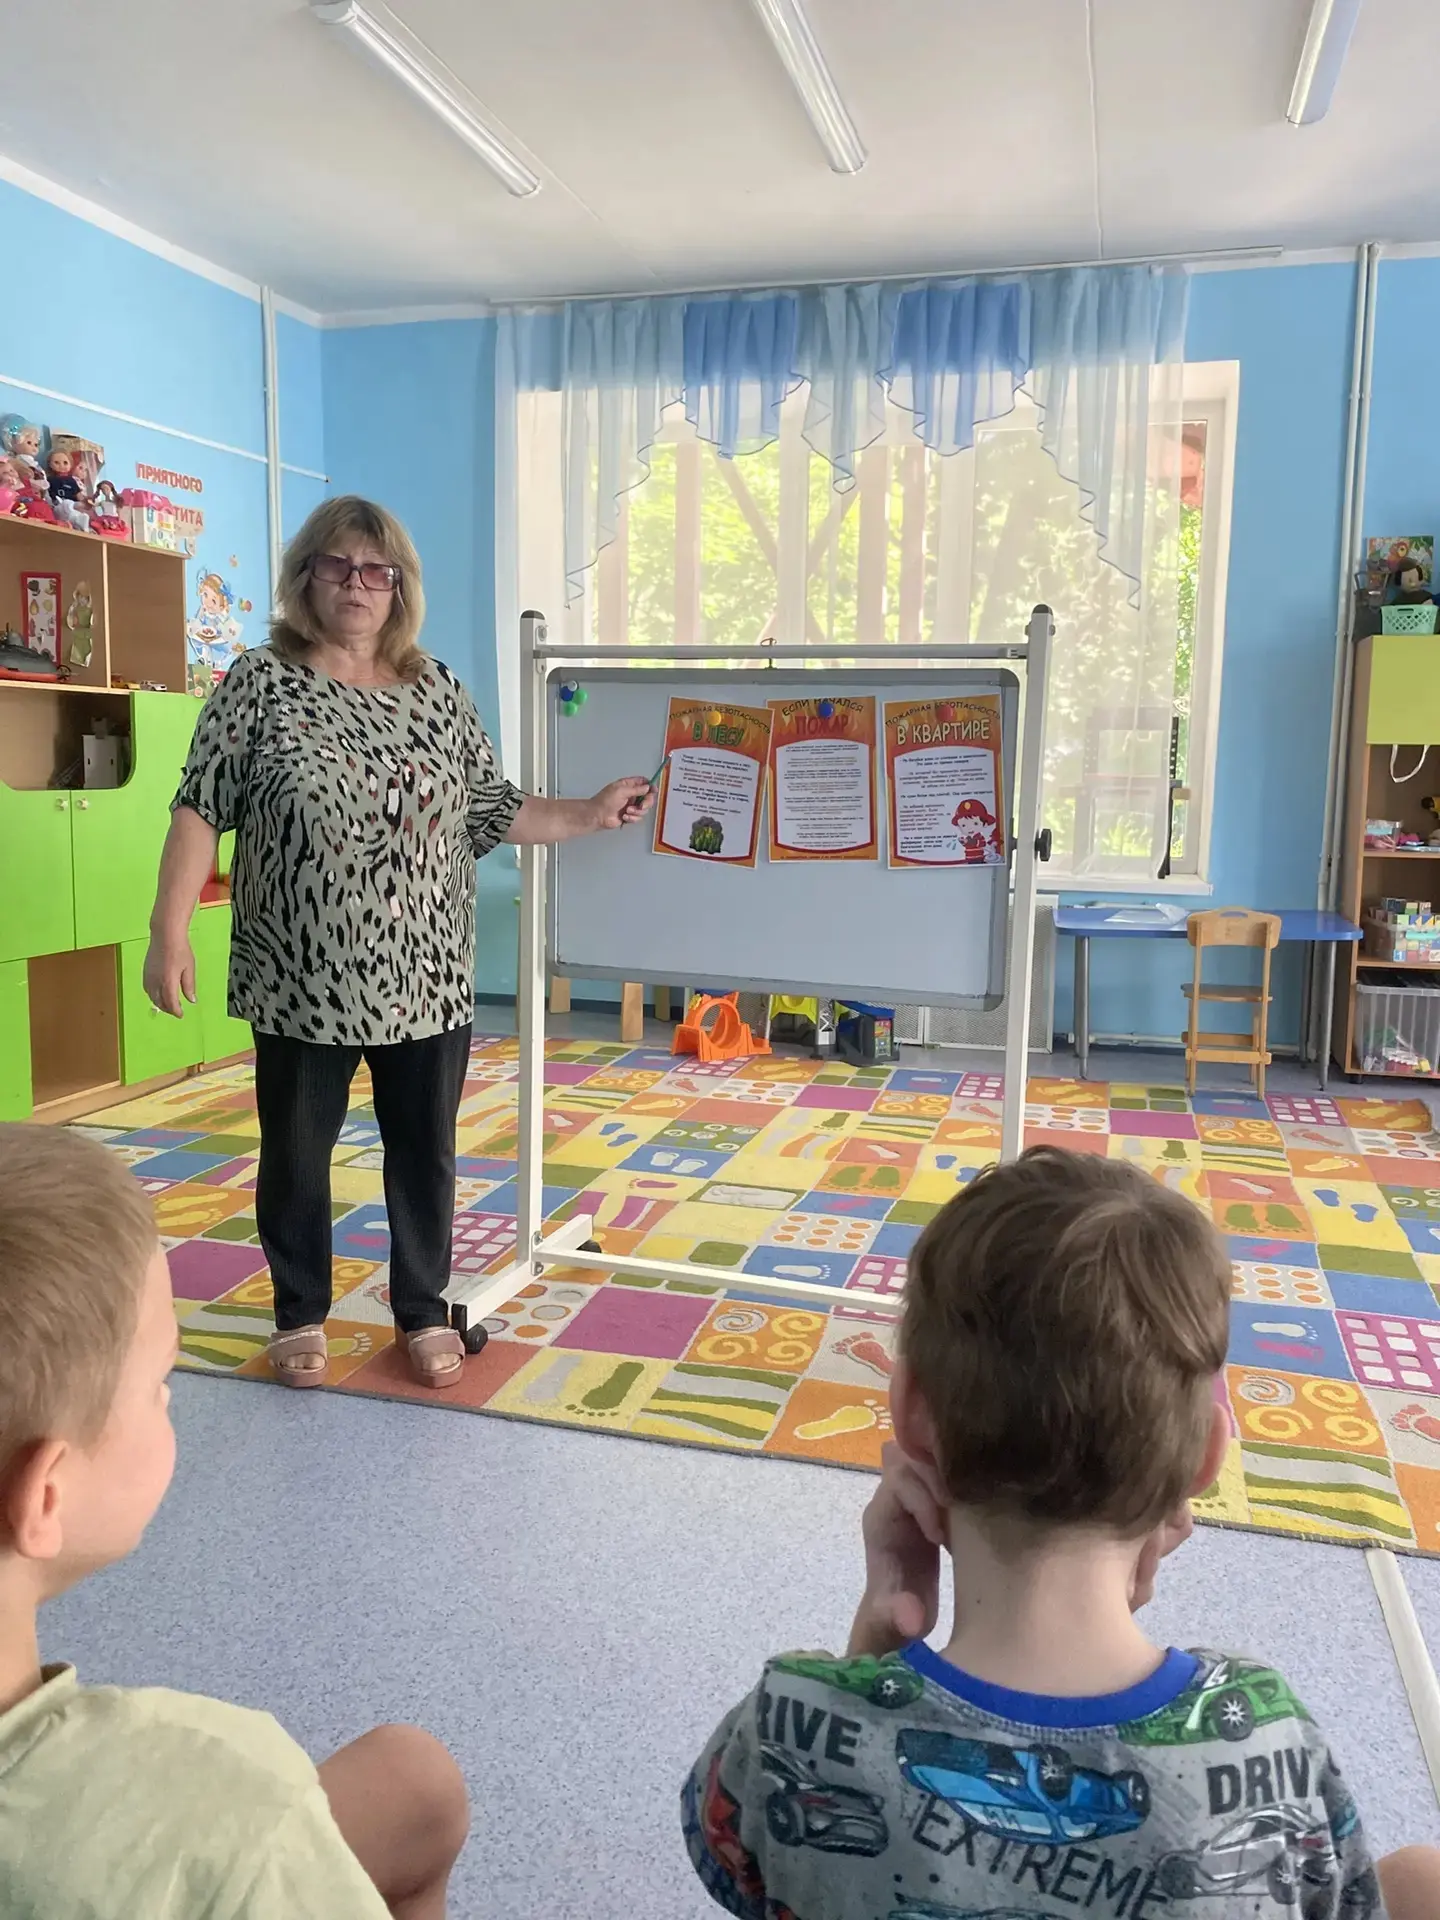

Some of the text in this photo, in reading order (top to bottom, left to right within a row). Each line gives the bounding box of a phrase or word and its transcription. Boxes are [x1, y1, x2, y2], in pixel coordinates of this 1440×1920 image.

[136, 463, 203, 493] ПРИЯТНОГО
[781, 699, 810, 717] ЕСЛИ
[884, 703, 931, 728] ПОЖАРНАЯ
[692, 721, 704, 741] В
[795, 714, 849, 736] ПОЖАР
[897, 719, 990, 745] В КВАРТИРЕ
[1206, 1746, 1318, 1816] DRIV
